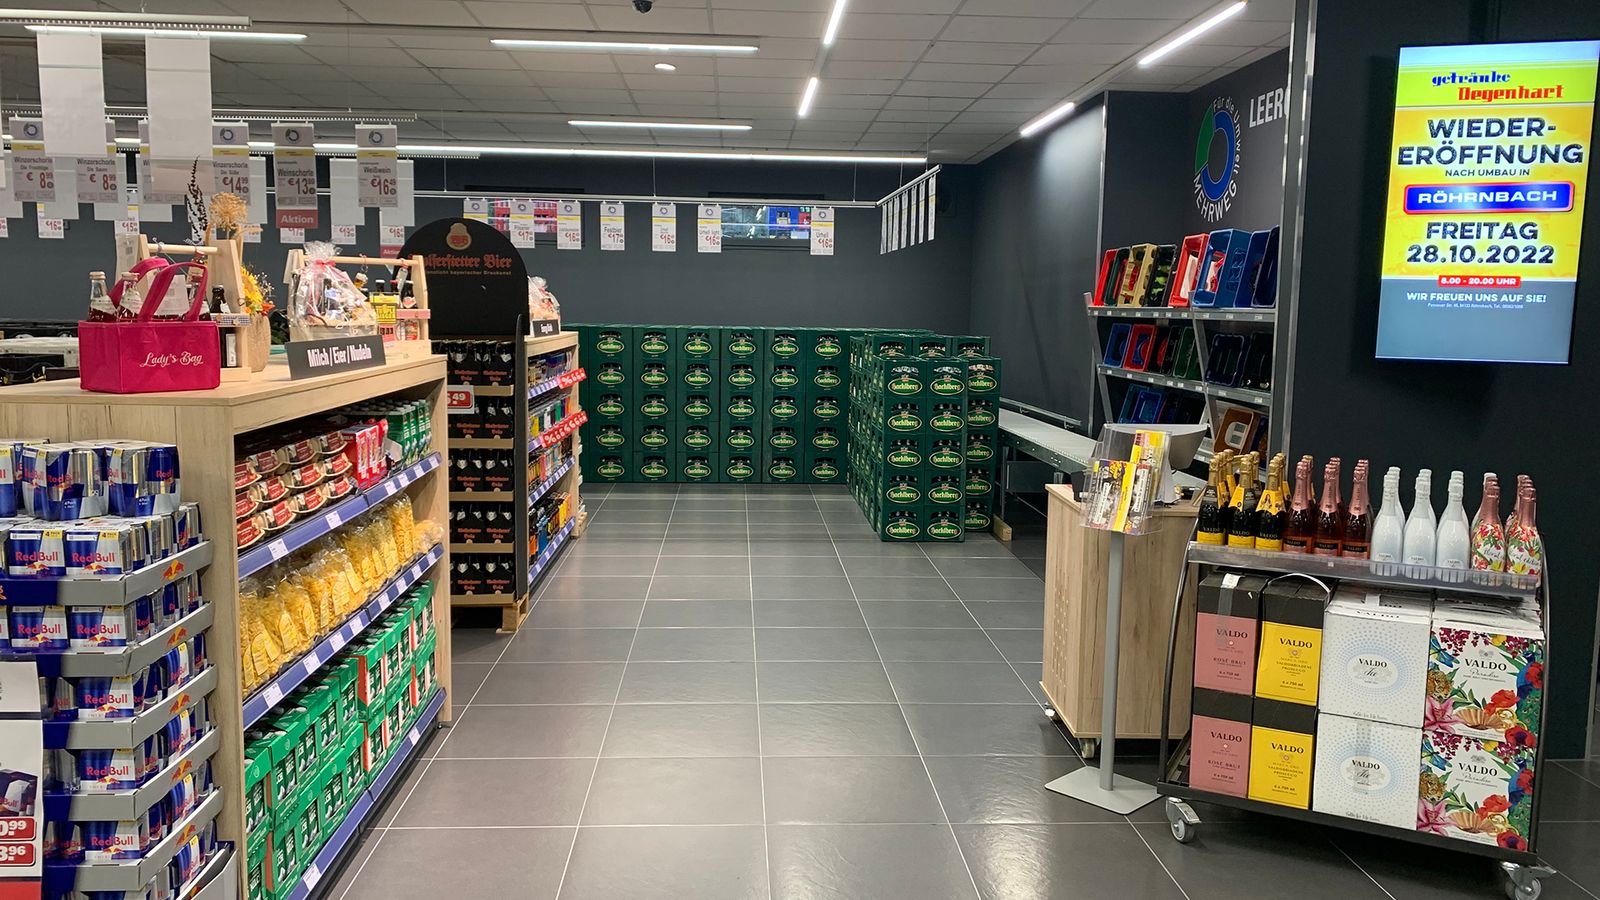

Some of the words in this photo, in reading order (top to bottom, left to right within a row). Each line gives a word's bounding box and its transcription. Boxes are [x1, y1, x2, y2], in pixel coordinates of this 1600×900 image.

[1431, 71, 1511, 86] getränke
[1458, 85, 1563, 102] Degenhart
[1213, 97, 1224, 112] Für
[1226, 96, 1235, 113] die
[1428, 117, 1557, 139] WIEDER-
[1398, 140, 1583, 165] ERÖFFNUNG
[277, 168, 314, 177] Weinschorle
[1445, 169, 1475, 177] NACH
[1478, 168, 1517, 176] UMBAU
[1519, 168, 1530, 176] IN
[1193, 174, 1237, 222] MEHRWEG
[1418, 190, 1557, 204] RÖHRNBACH
[281, 215, 314, 224] Aktion
[1426, 221, 1539, 240] FREITAG
[1406, 244, 1555, 264] 28.10.2022
[483, 253, 513, 269] Bier
[1441, 277, 1461, 285] 8.00
[1468, 277, 1495, 285] 20.00
[1496, 277, 1516, 285] UHR
[1406, 292, 1427, 301] WIR
[1429, 292, 1472, 301] FREUEN
[1475, 293, 1498, 302] UNS
[1500, 294, 1523, 303] AUF
[1525, 294, 1547, 303] SIE!
[139, 352, 178, 368] Lady's
[180, 351, 204, 366] Bag
[307, 346, 330, 367] Milch
[333, 345, 346, 364] Eier
[350, 343, 372, 362] Nudeln
[15, 551, 37, 562] Red
[38, 552, 59, 561] Bull
[71, 552, 94, 563] Red
[95, 552, 115, 562] Bull
[17, 624, 39, 634] Red
[41, 624, 61, 633] Bull
[76, 624, 98, 634] Red
[100, 624, 120, 633] Bull
[1216, 628, 1248, 639] VALDO
[1280, 637, 1313, 649] VALDO
[1358, 658, 1388, 668] VALDO
[1464, 658, 1507, 671] VALDO
[84, 694, 106, 704] Red
[108, 694, 128, 704] Bull
[1210, 731, 1243, 743] VALDO
[1271, 742, 1304, 754] VALDO
[1351, 759, 1381, 770] VALDO
[1458, 762, 1498, 777] VALDO
[86, 766, 107, 776] Red
[109, 766, 129, 776] Bull
[91, 836, 112, 846] Red
[113, 836, 134, 846] Bull
